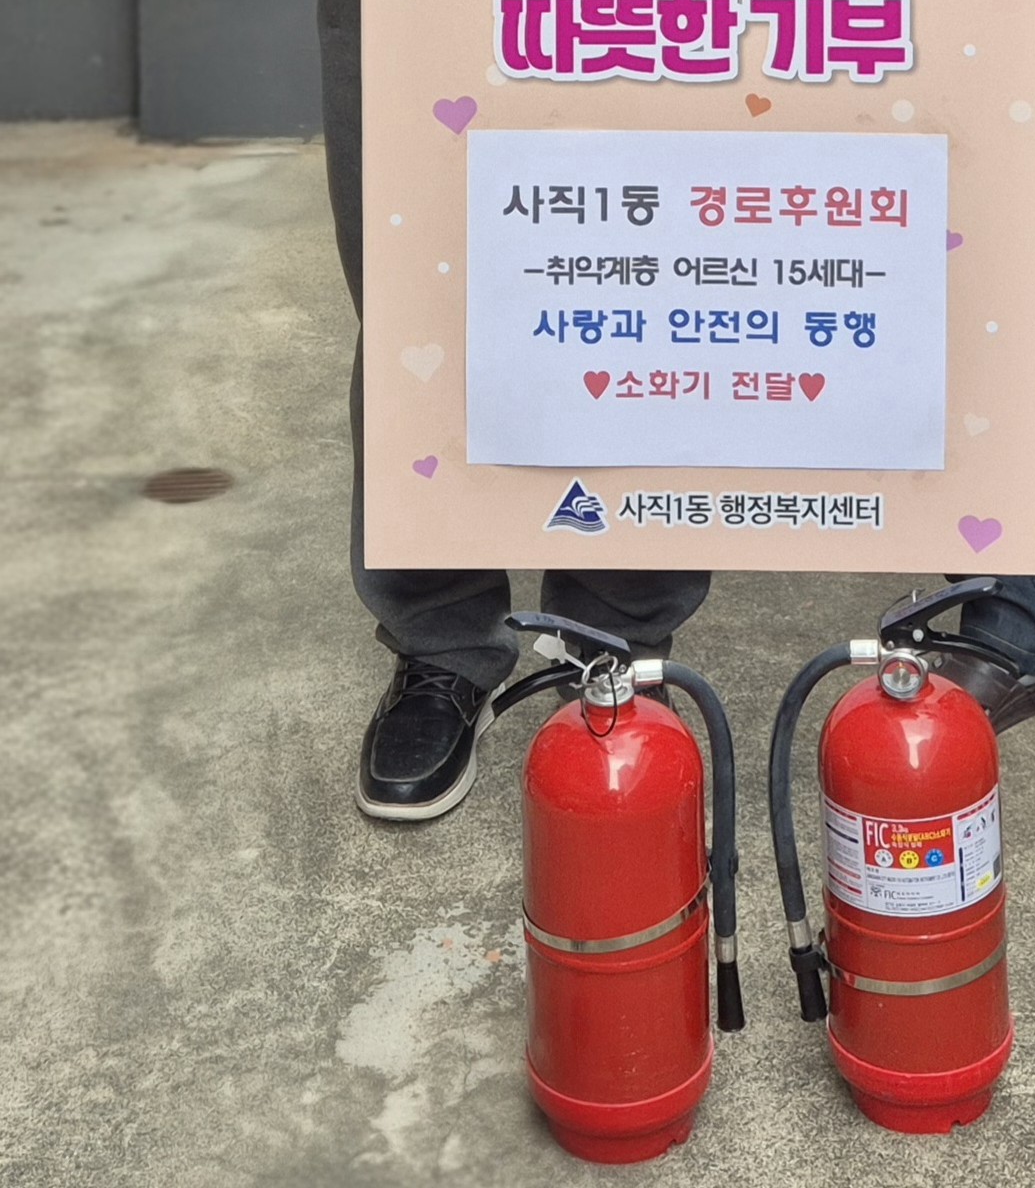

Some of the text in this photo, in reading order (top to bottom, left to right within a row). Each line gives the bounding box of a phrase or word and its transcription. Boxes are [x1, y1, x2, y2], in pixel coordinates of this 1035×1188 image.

[502, 184, 908, 228] 사직1동 경로후원회
[673, 256, 759, 287] 어르신
[532, 308, 877, 349] 사랑과 안전의 동행
[615, 369, 796, 402] 소화기 전달
[618, 492, 881, 527] 사직1동 행정복지센터
[865, 820, 891, 849] FIC
